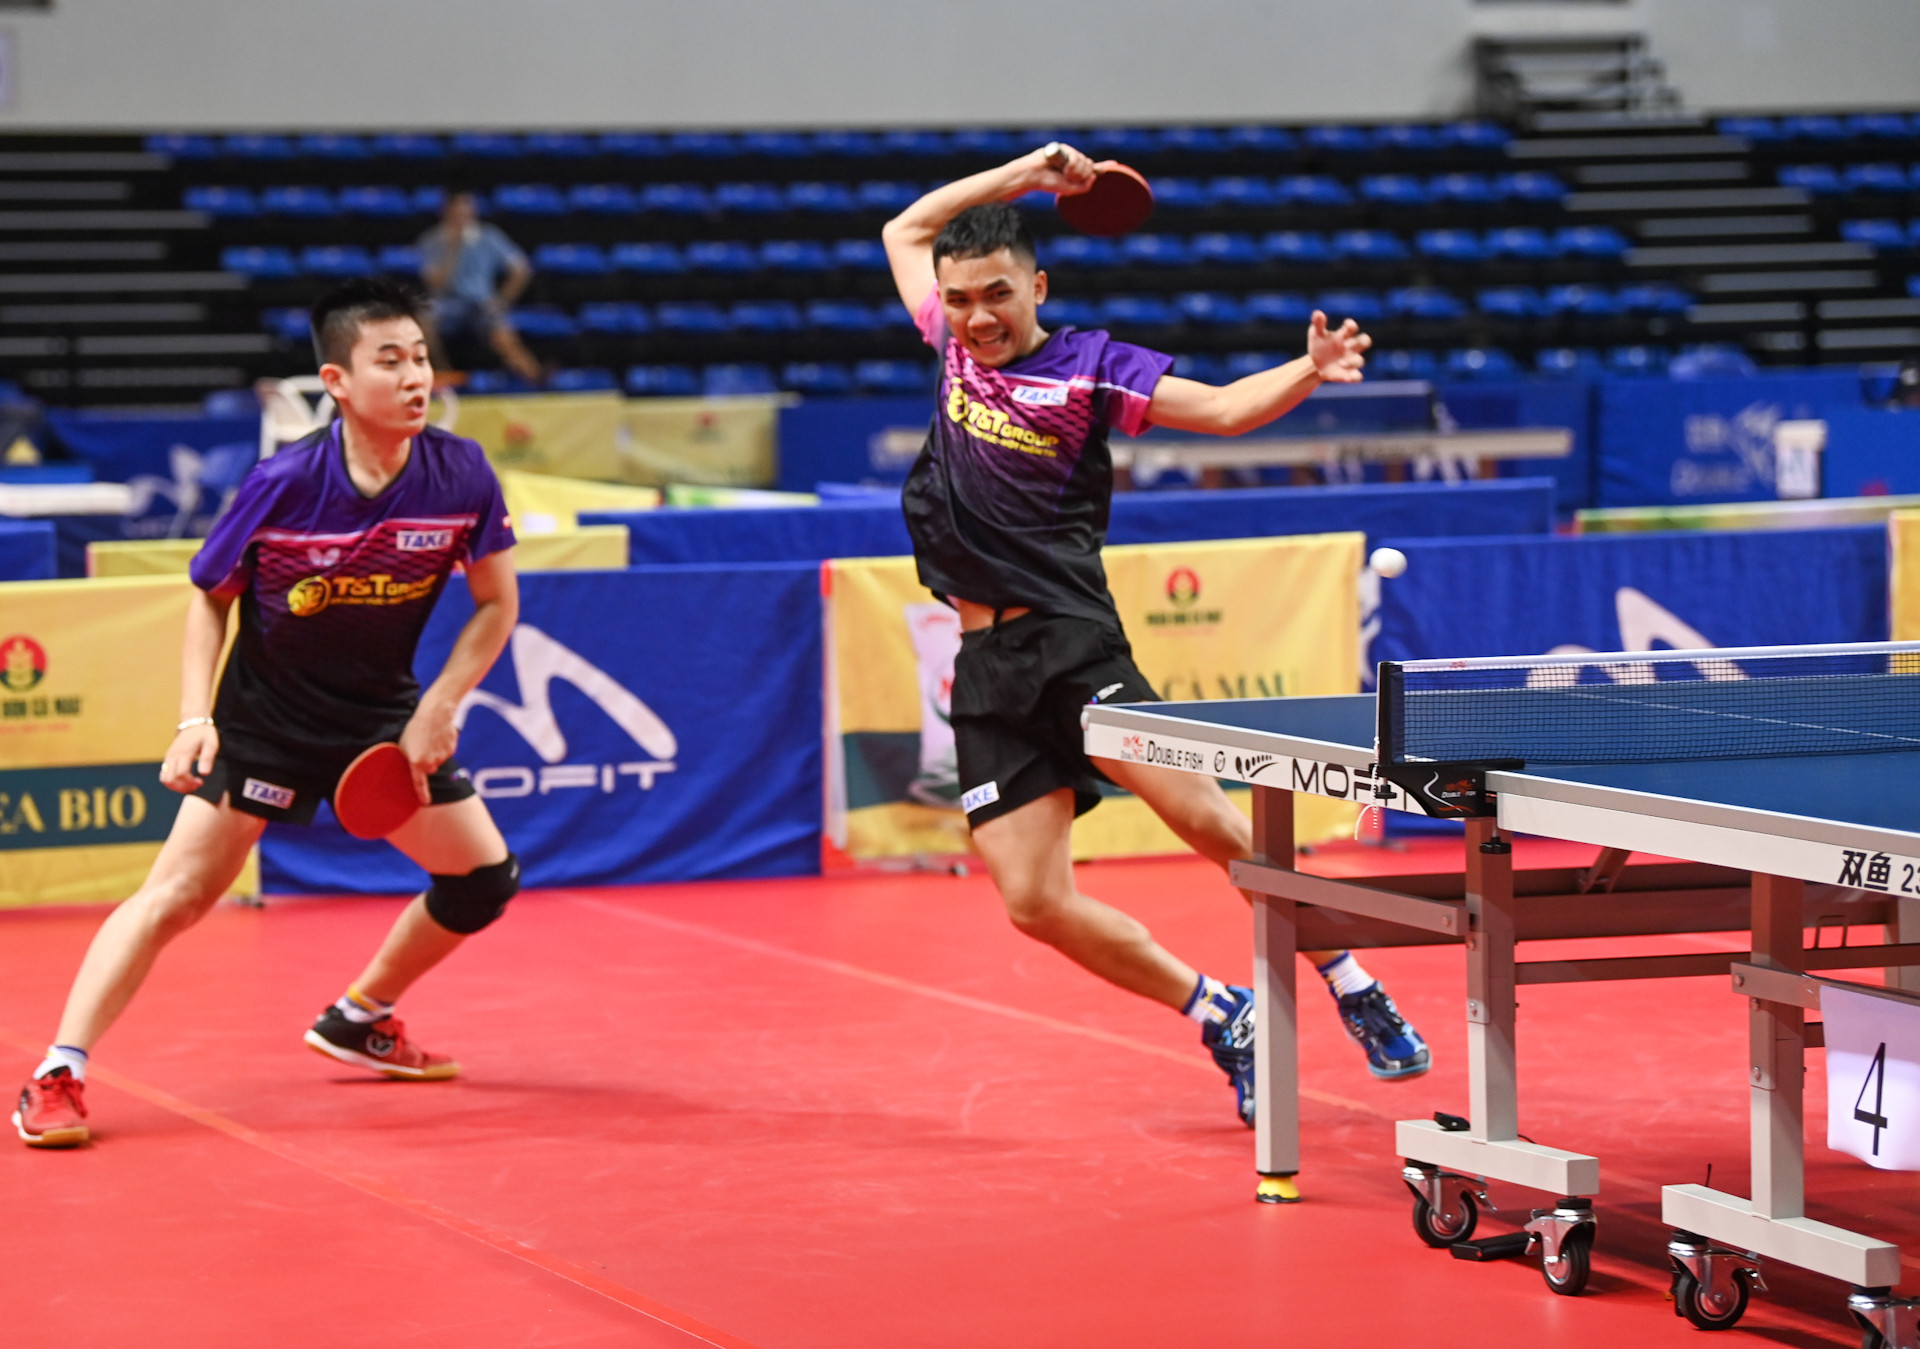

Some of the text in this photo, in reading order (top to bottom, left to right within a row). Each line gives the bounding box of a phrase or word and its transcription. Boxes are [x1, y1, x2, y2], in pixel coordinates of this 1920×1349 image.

[1018, 388, 1063, 405] TAKE
[403, 535, 450, 547] TAKE
[1147, 740, 1182, 767] DOUBLE
[1184, 750, 1203, 771] FISH
[251, 783, 289, 803] TAKE
[463, 761, 677, 798] OFIT
[1292, 758, 1408, 812] MOF
[59, 785, 147, 831] BIO
[1837, 850, 1891, 891] 双鱼
[1854, 1042, 1888, 1156] 4
